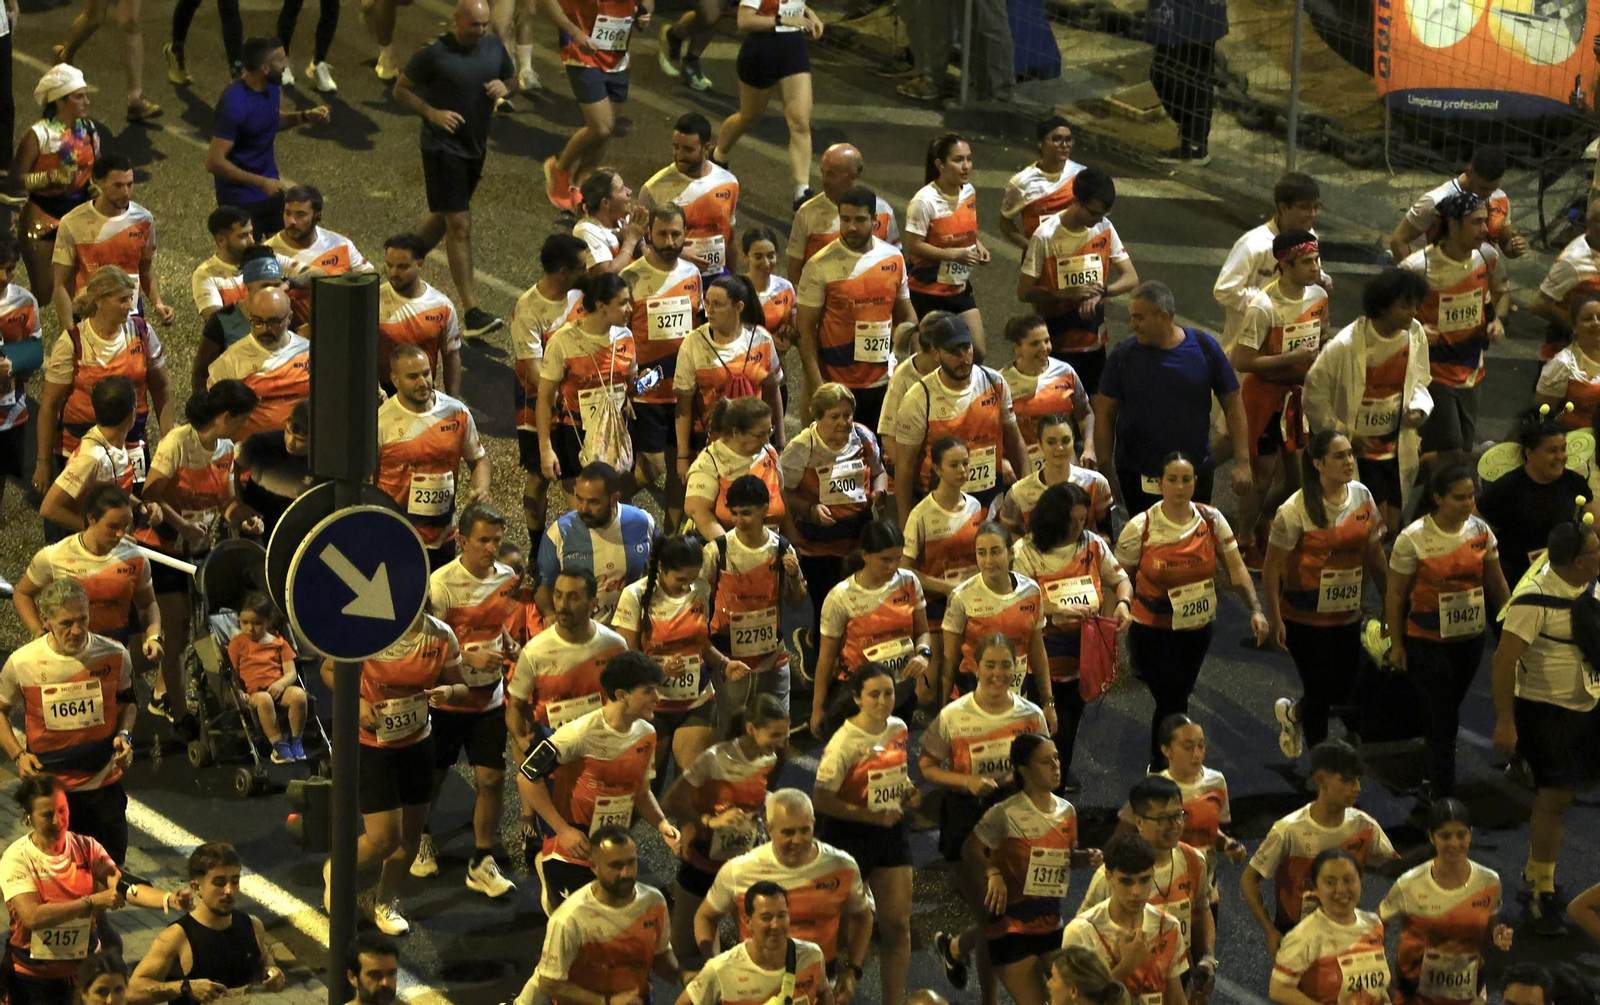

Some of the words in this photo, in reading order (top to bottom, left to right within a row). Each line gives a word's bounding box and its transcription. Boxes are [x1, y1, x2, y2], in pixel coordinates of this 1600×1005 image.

[1407, 94, 1441, 108] Limpieza
[1443, 100, 1499, 110] profesional
[1064, 270, 1098, 286] 10853
[658, 314, 684, 328] 3277
[1445, 305, 1478, 323] 16196
[864, 338, 889, 352] 3276
[829, 478, 856, 493] 2300
[415, 490, 450, 504] 23299
[1326, 585, 1358, 600] 19429
[1182, 599, 1209, 617] 2280
[1446, 606, 1480, 624] 19427
[736, 627, 773, 644] 22793
[50, 699, 95, 718] 16641
[385, 711, 417, 730] 9331
[1033, 867, 1067, 884] 13115
[42, 929, 79, 946] 2157
[1348, 972, 1384, 993] 24162
[1429, 970, 1470, 987] 10604
